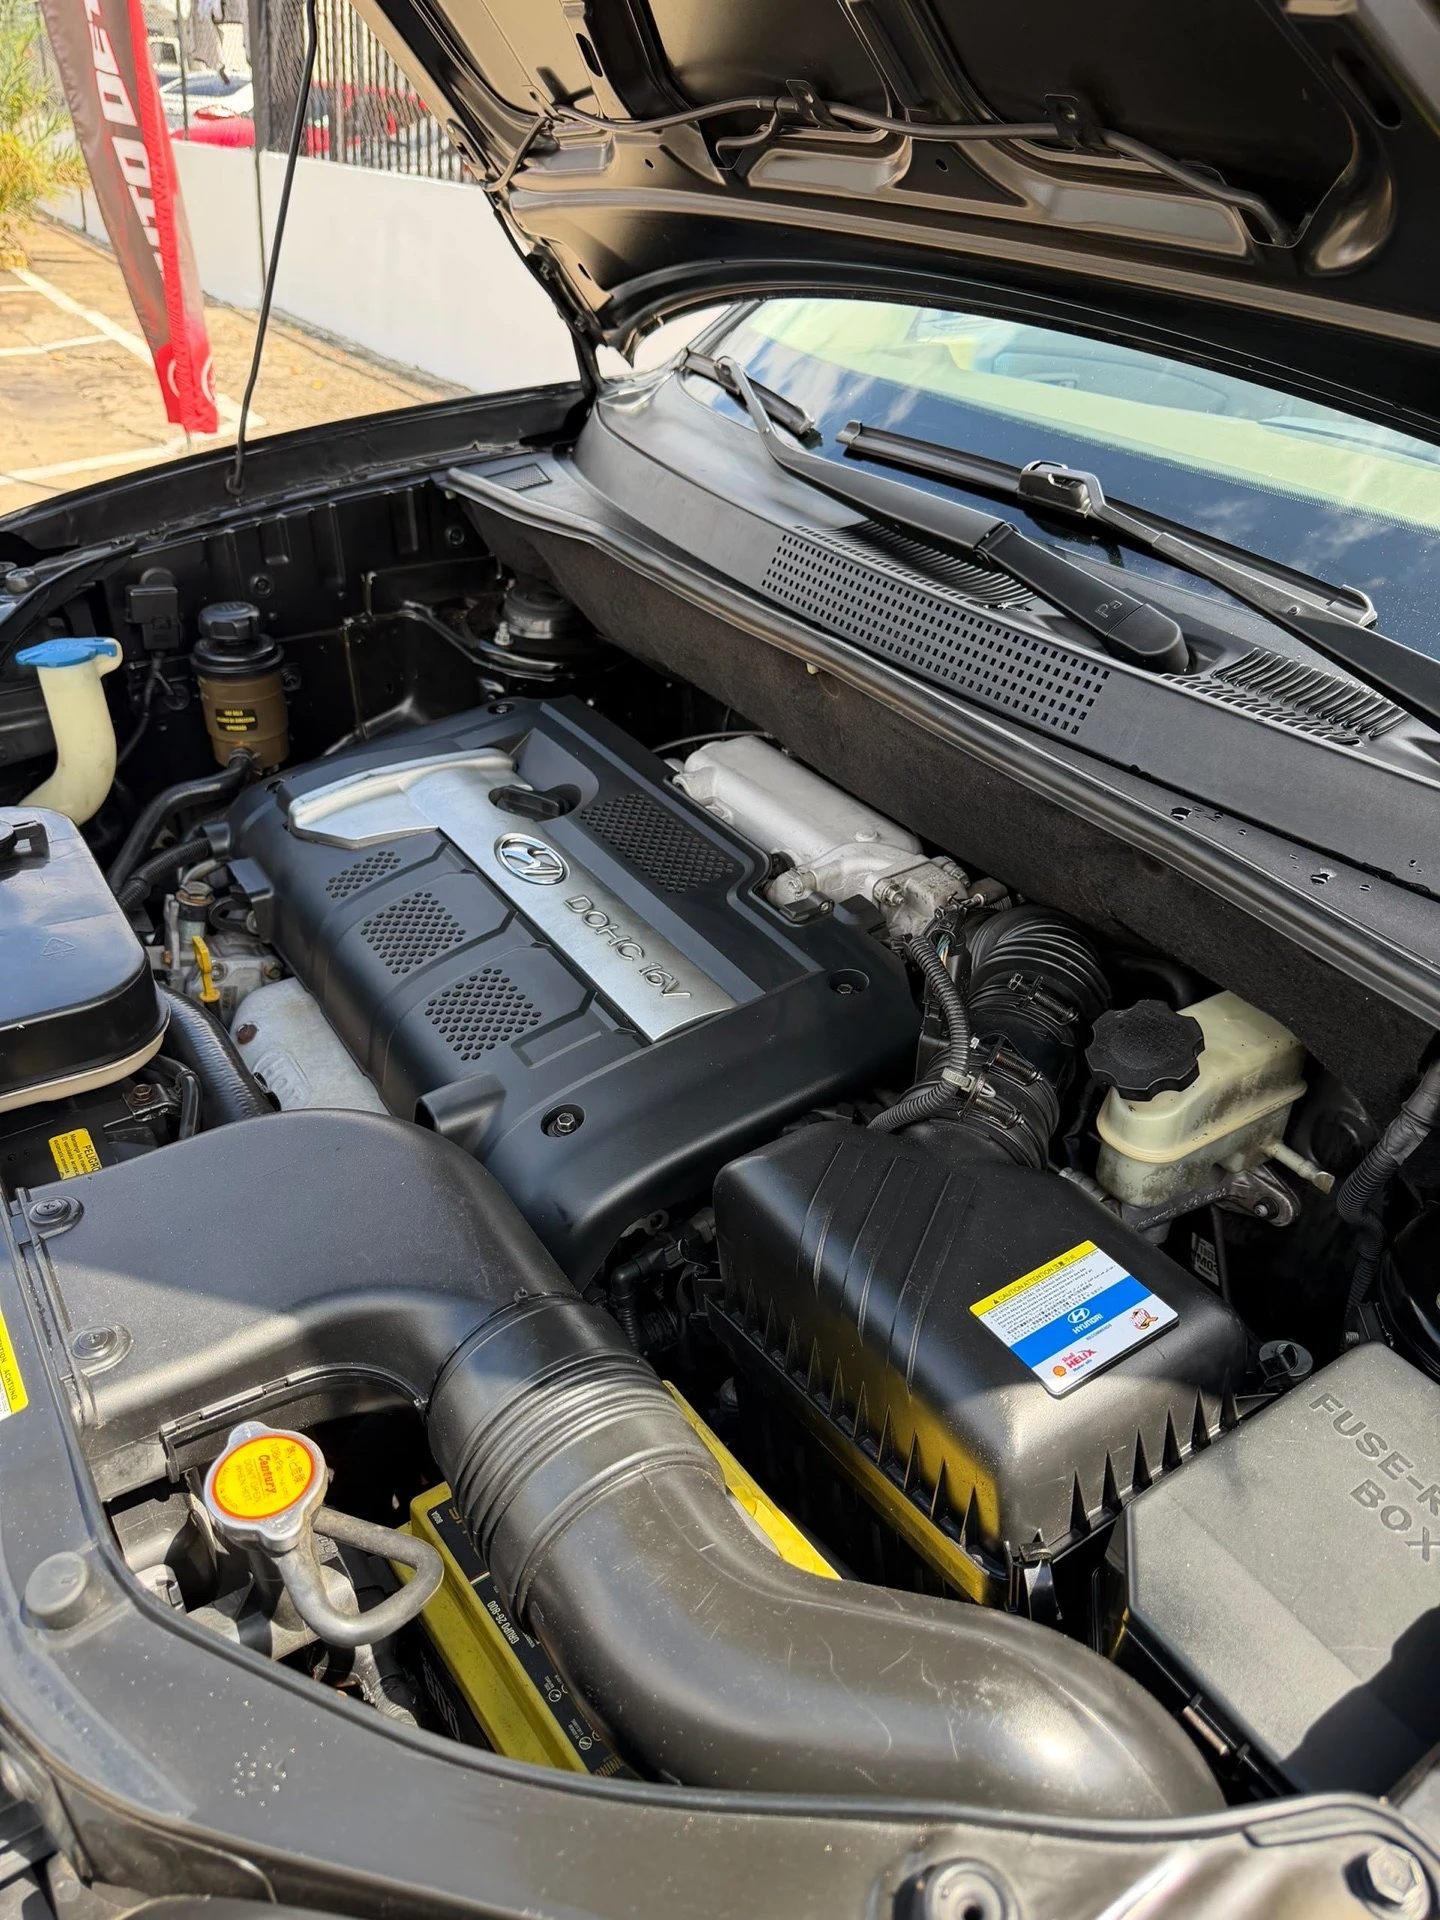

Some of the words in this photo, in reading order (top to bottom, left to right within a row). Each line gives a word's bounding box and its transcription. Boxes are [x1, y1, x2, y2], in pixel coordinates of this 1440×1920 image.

[564, 894, 645, 961] DOHC
[639, 962, 692, 998] 16V
[998, 1282, 1025, 1301] CAUTION
[1023, 1267, 1054, 1288] ATTENTION
[1072, 1313, 1104, 1335] HYUNDAI
[1066, 1348, 1097, 1369] HELIX
[4, 1369, 18, 1400] ACHTUNG
[258, 1454, 277, 1493] Century
[1350, 1478, 1440, 1563] BOX
[486, 1600, 507, 1627] 26-800
[501, 1621, 520, 1645] GRUPO
